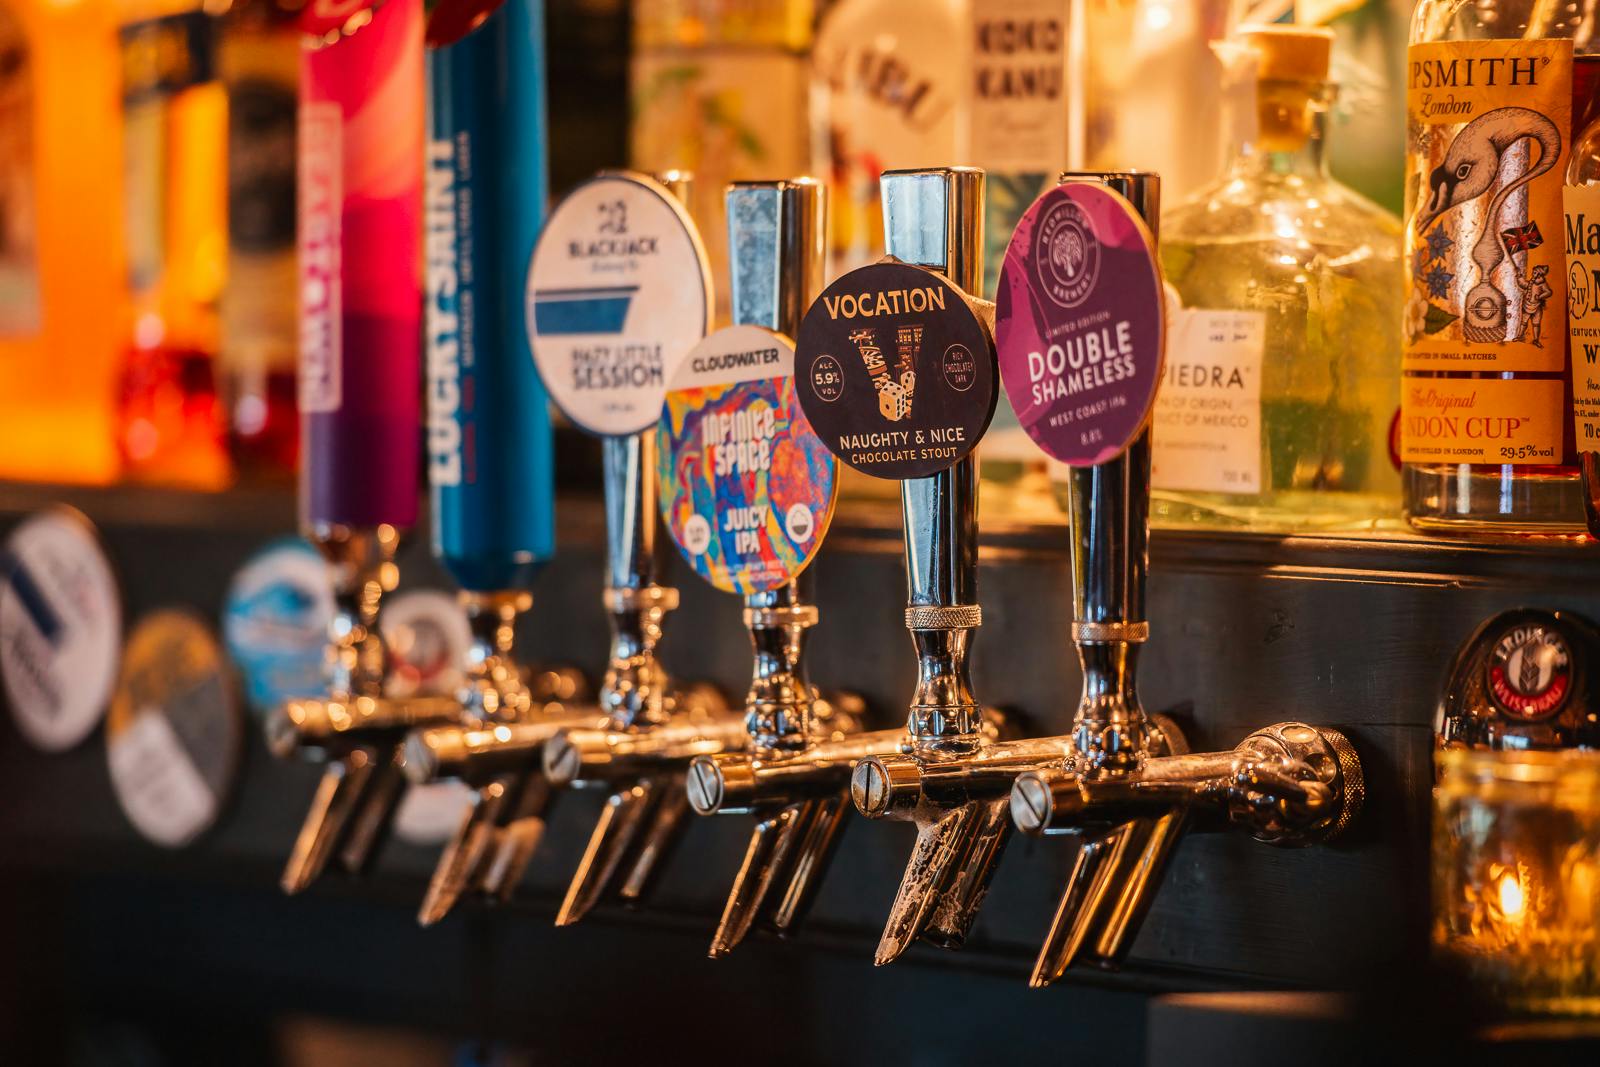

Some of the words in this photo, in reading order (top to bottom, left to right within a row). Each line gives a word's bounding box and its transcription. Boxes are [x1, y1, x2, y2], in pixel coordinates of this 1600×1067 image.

[976, 20, 1058, 53] KOKO
[976, 67, 1060, 99] KANU
[1420, 94, 1472, 118] London
[568, 238, 659, 258] BLACKJACK
[1053, 273, 1091, 301] BREWERY
[823, 286, 946, 320] VOCATION
[1077, 310, 1111, 329] EDITION
[692, 348, 780, 372] CLOUDWATER
[1027, 320, 1134, 384] DOUBLE
[573, 364, 664, 390] SESSION
[819, 362, 833, 370] ALC
[815, 372, 840, 385] 5.9%
[1031, 353, 1136, 406] SHAMELESS
[821, 387, 836, 395] VOL
[1049, 410, 1074, 427] WEST
[1075, 400, 1107, 420] COAST
[1203, 415, 1249, 428] MEXICO
[839, 432, 909, 450] NAUGHTY
[915, 430, 926, 445] &
[931, 427, 966, 443] NICE
[851, 450, 917, 465] CHOCOLATE
[921, 446, 958, 459] STOUT
[724, 505, 769, 532] JUICY
[735, 530, 761, 555] IPA
